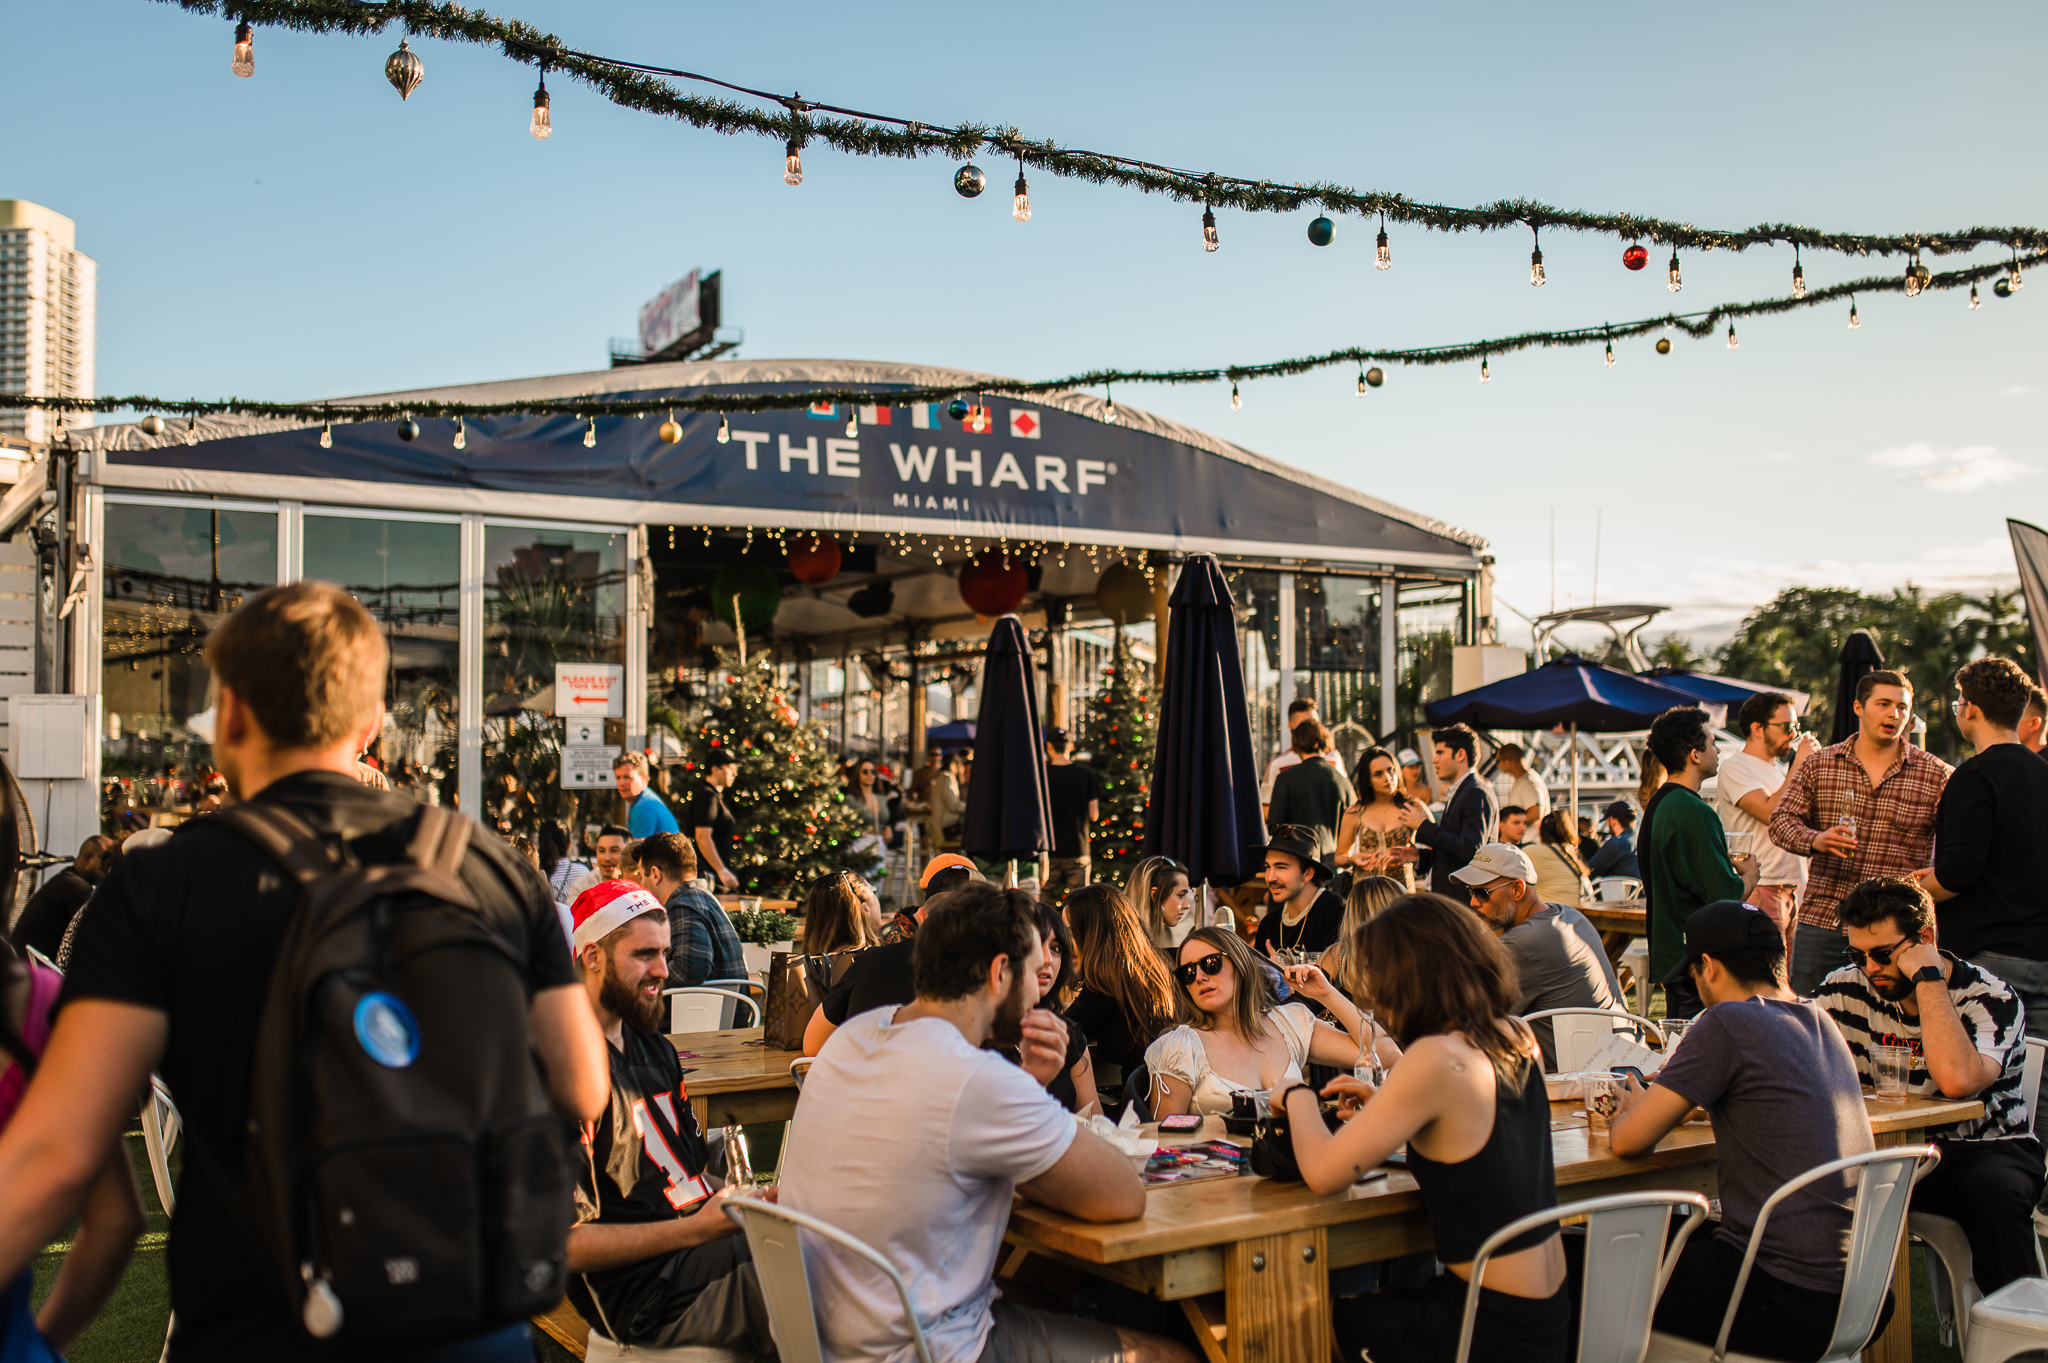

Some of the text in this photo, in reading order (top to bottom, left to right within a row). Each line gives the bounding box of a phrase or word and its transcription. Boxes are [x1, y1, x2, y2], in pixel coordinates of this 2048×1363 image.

[731, 430, 861, 478] THE
[893, 492, 970, 512] MIAMI
[561, 675, 618, 685] PLEASE EXIT
[569, 683, 611, 691] THIS WAY
[626, 899, 650, 913] THE
